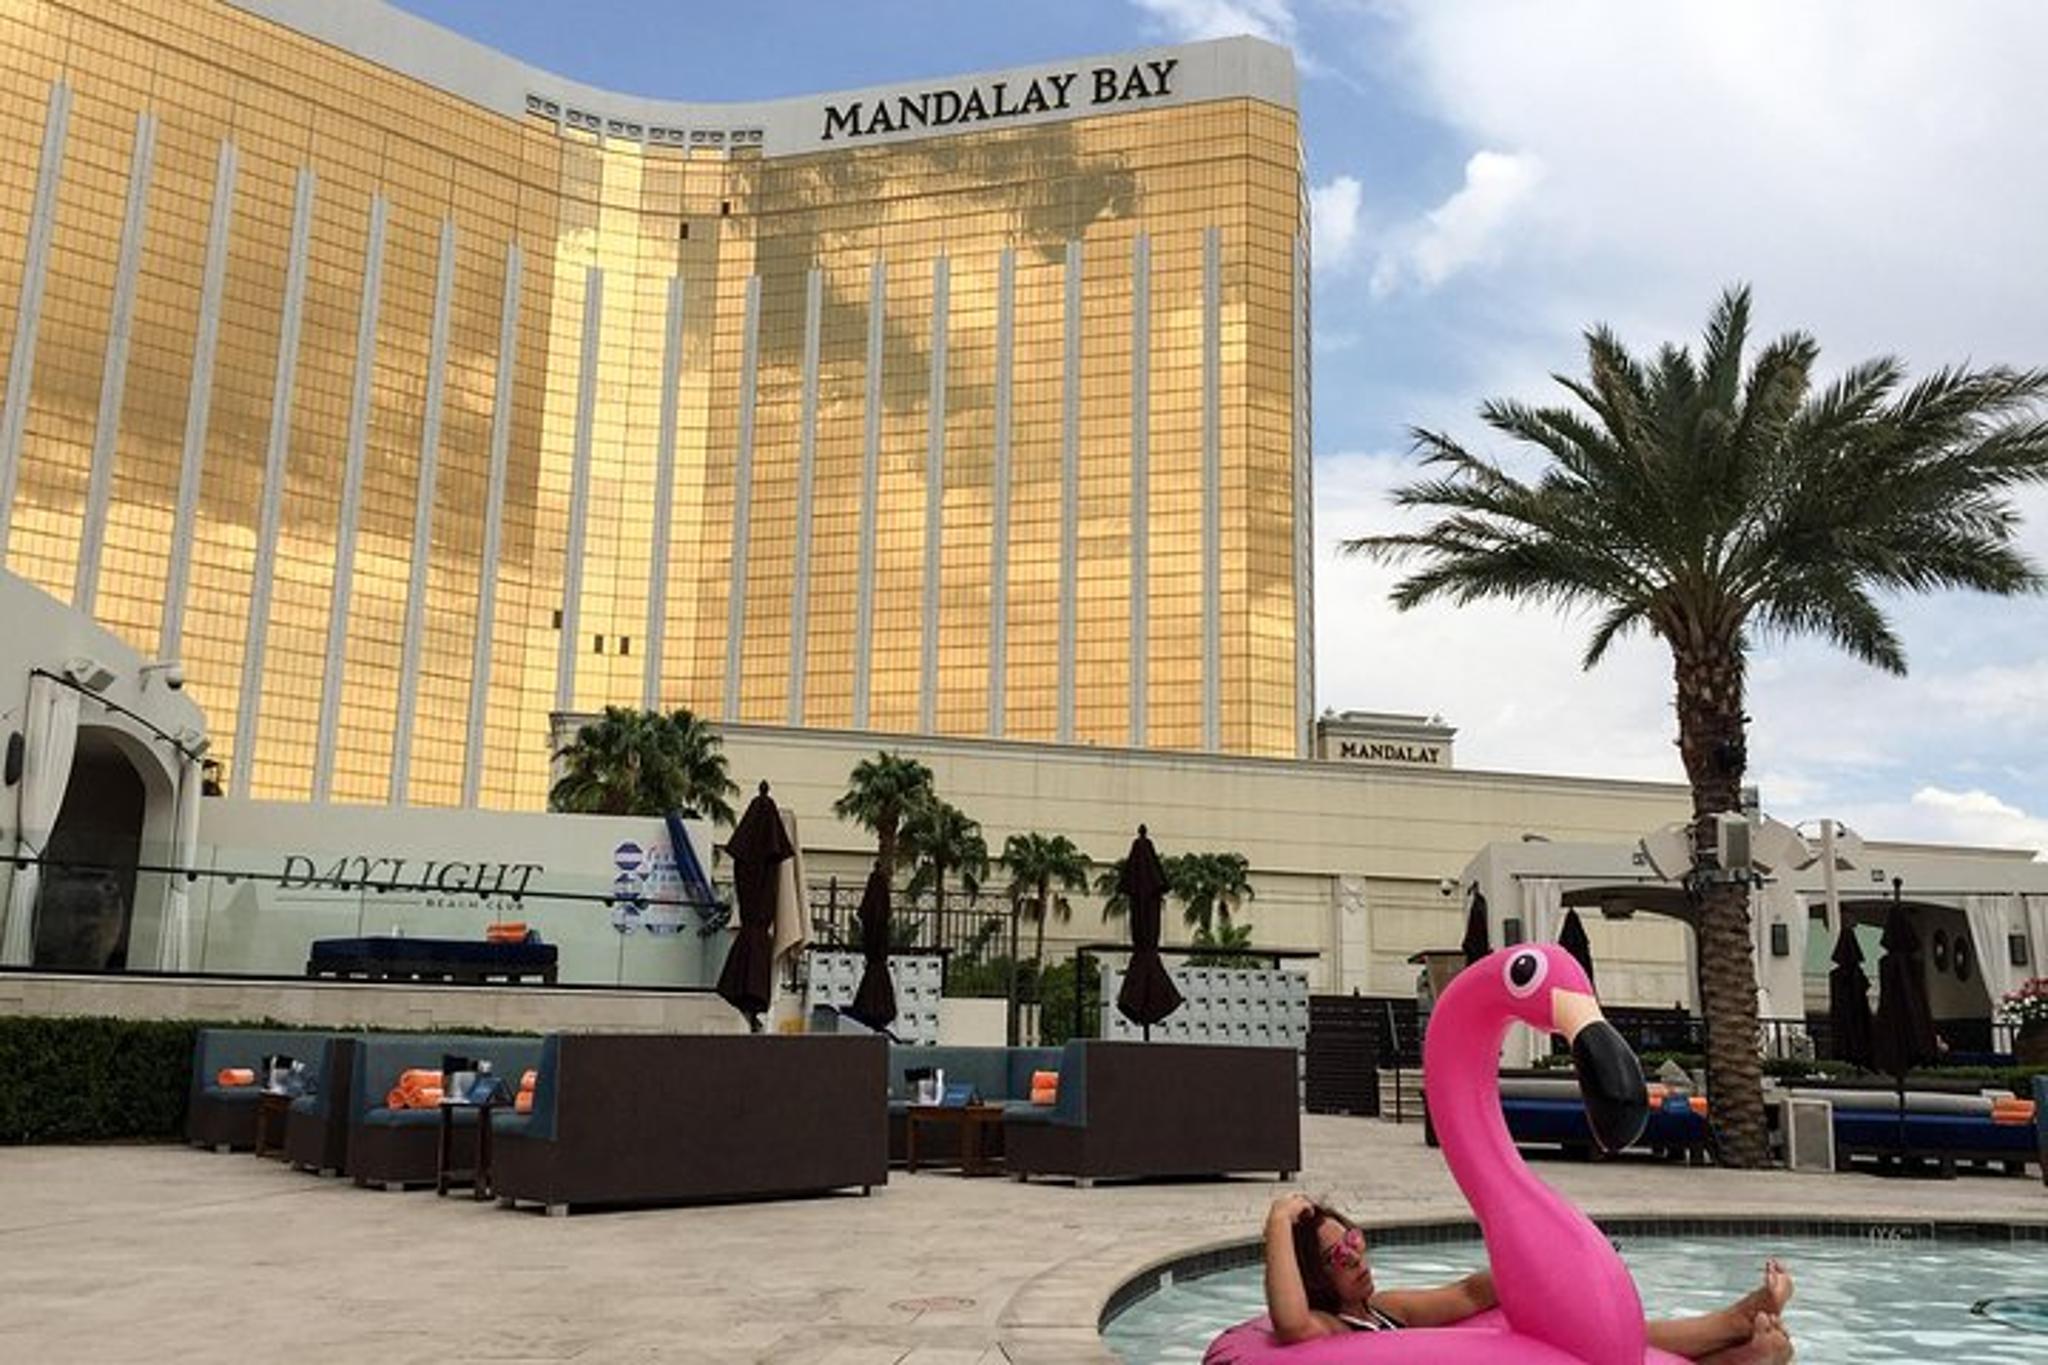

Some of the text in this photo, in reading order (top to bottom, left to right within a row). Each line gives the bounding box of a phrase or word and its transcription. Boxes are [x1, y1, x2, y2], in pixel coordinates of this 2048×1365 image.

[822, 59, 1178, 139] MANDALAY BAY
[1341, 742, 1440, 763] MANDALAY
[277, 854, 544, 896] DAYLIGHT
